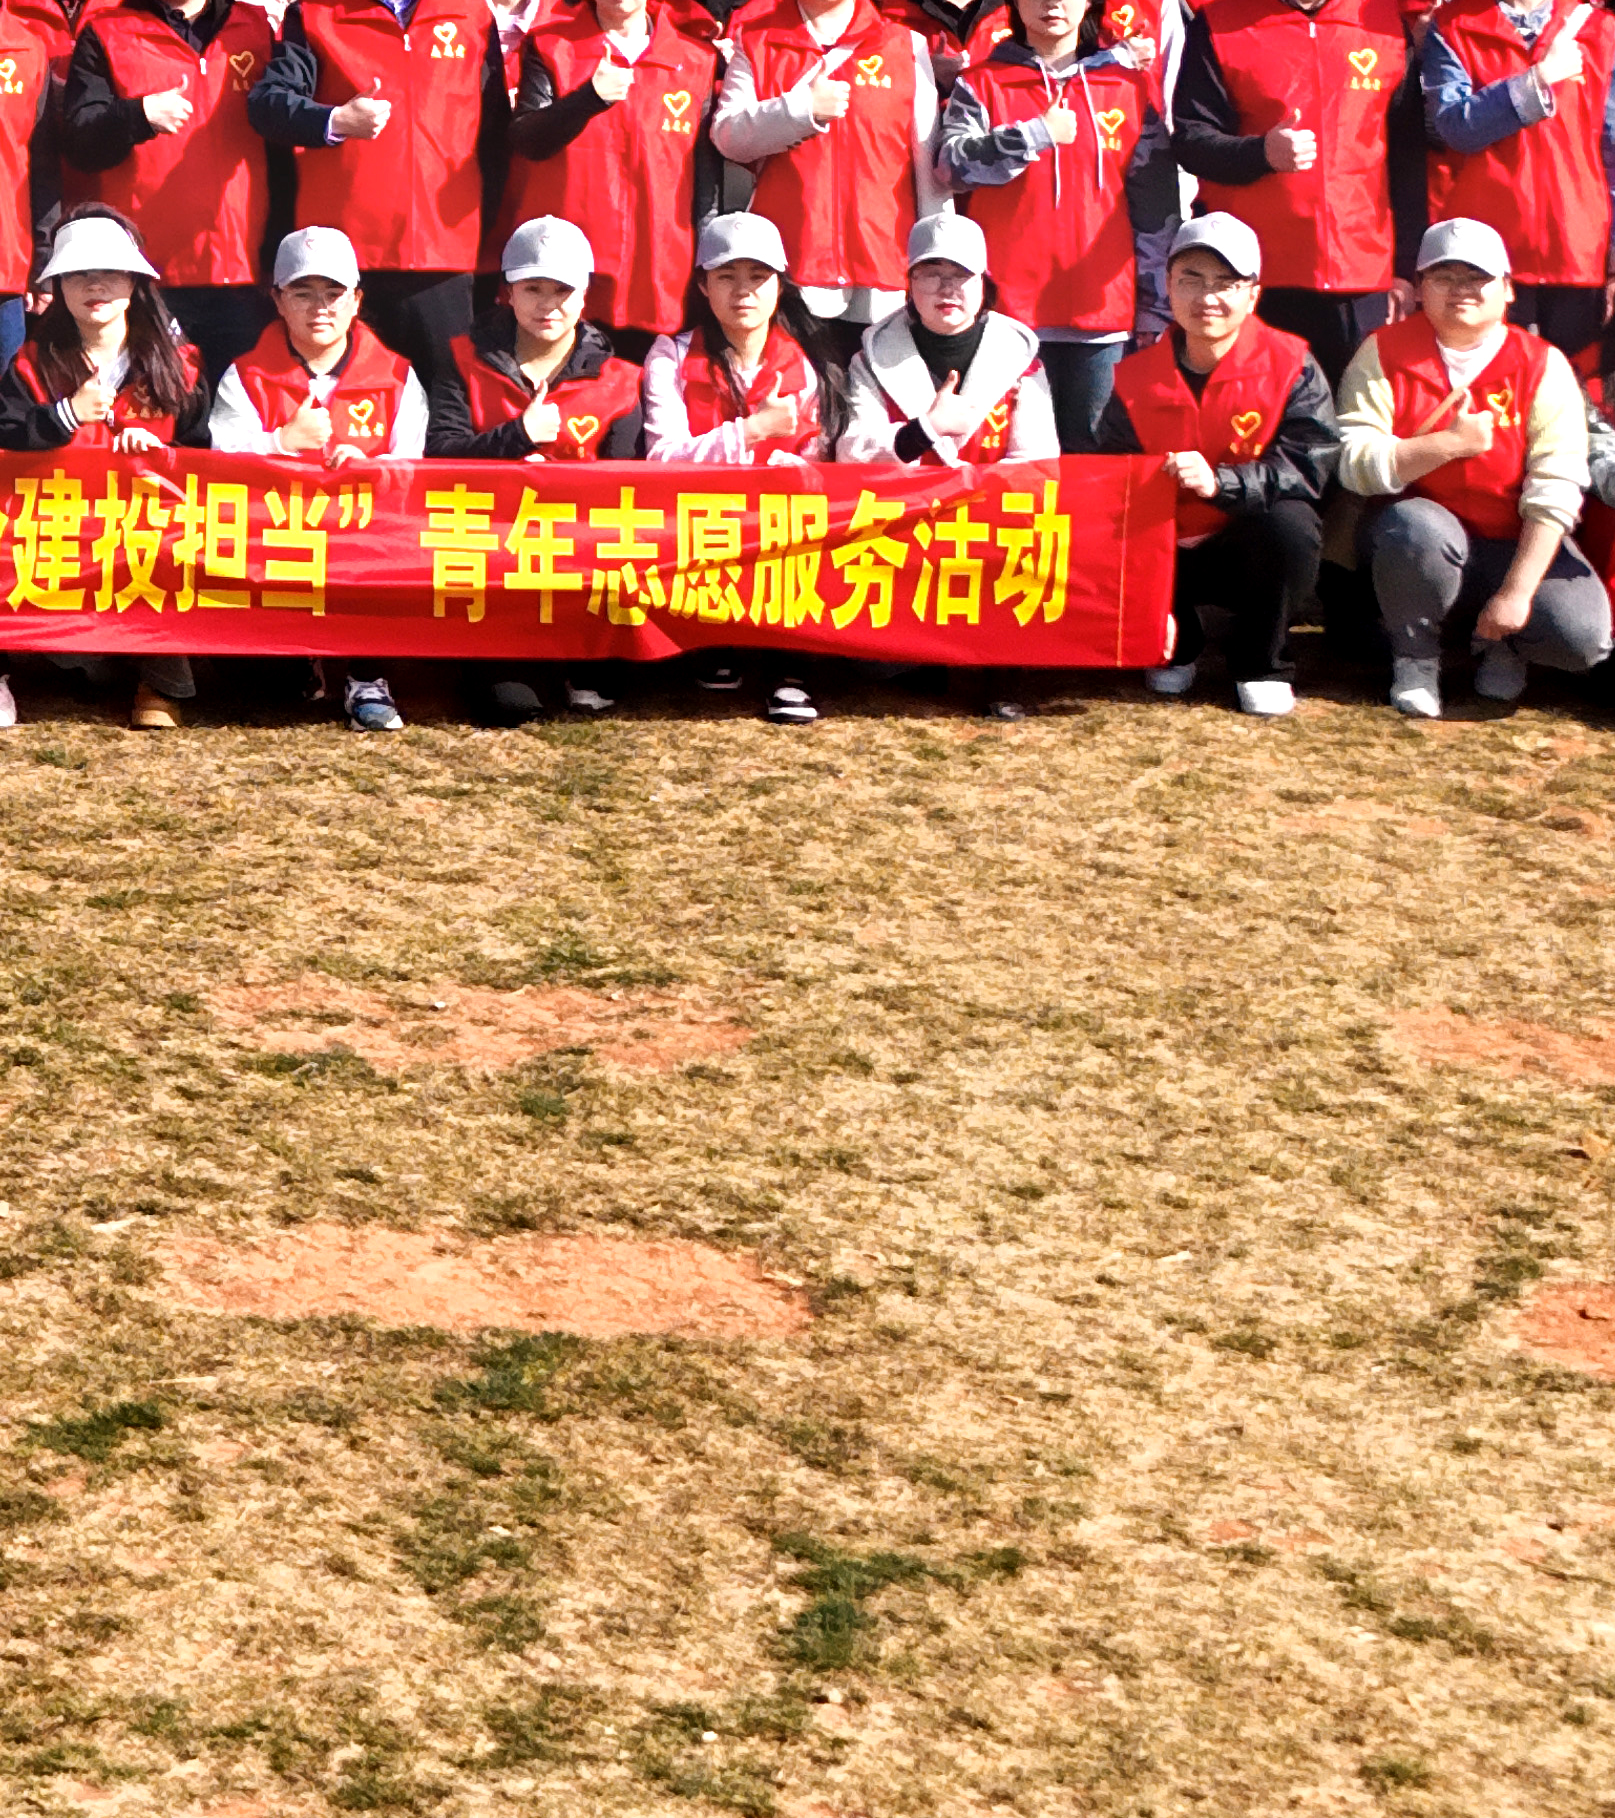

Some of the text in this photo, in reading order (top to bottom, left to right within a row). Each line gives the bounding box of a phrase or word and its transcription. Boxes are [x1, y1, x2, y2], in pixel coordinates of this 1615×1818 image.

[419, 478, 1071, 630] 青年志愿服务活动
